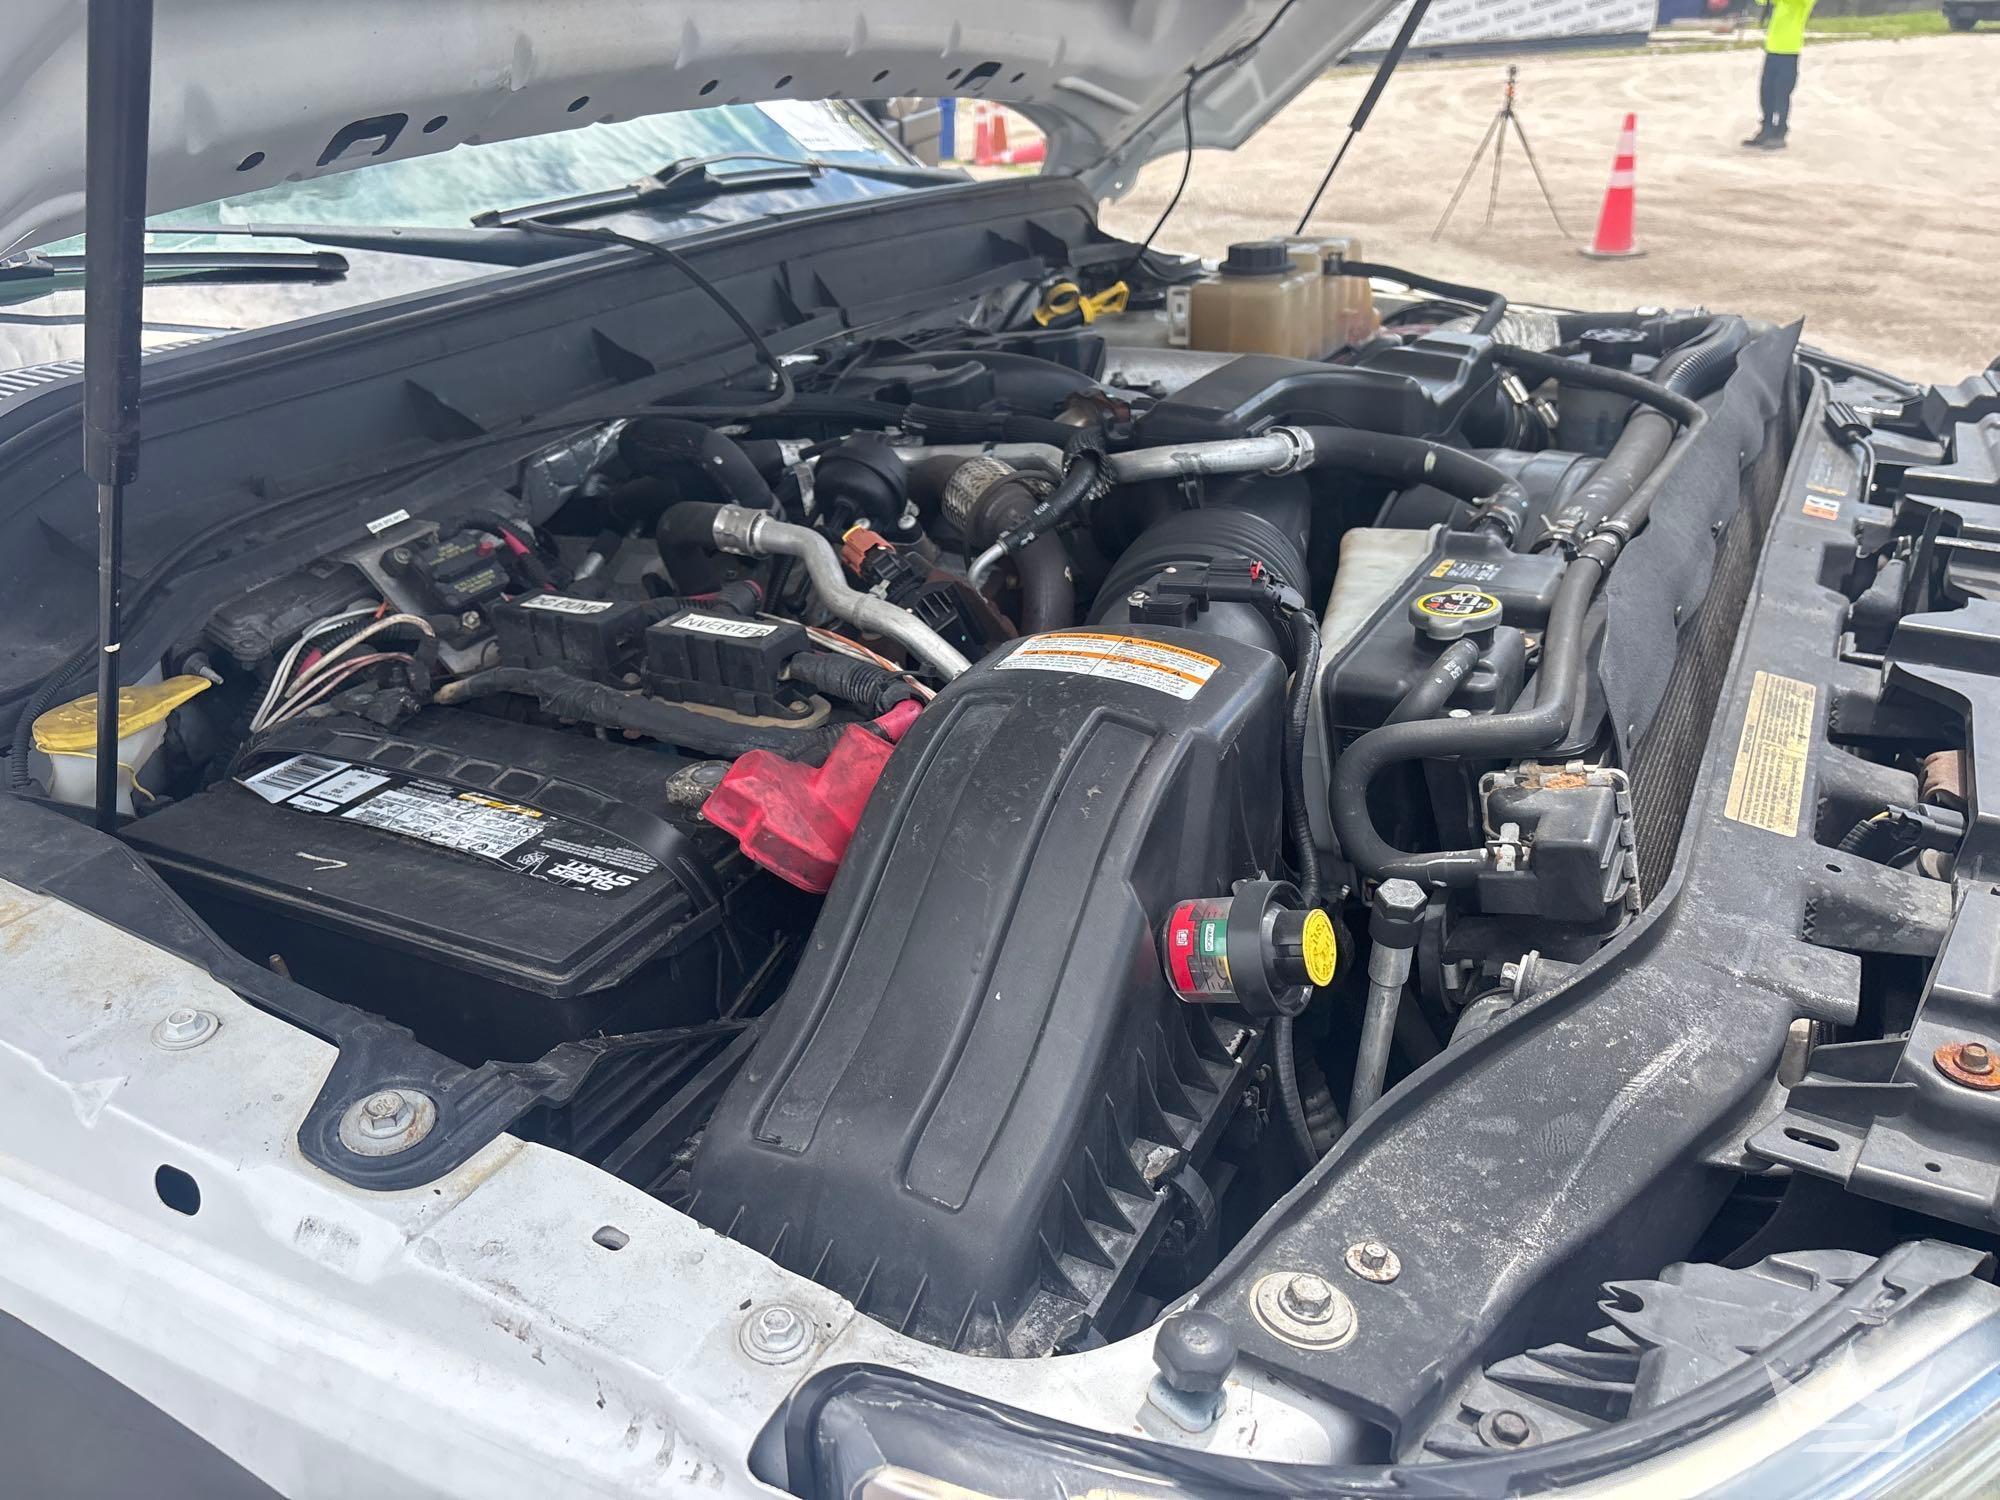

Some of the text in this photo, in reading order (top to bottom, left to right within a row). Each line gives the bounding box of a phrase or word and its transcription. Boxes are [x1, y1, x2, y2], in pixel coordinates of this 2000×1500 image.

[529, 597, 608, 613] DC PUMP
[679, 616, 770, 637] INVERTER
[1137, 639, 1202, 659] AVERTISSEMENT
[547, 866, 614, 891] SUPER
[564, 860, 640, 887] START
